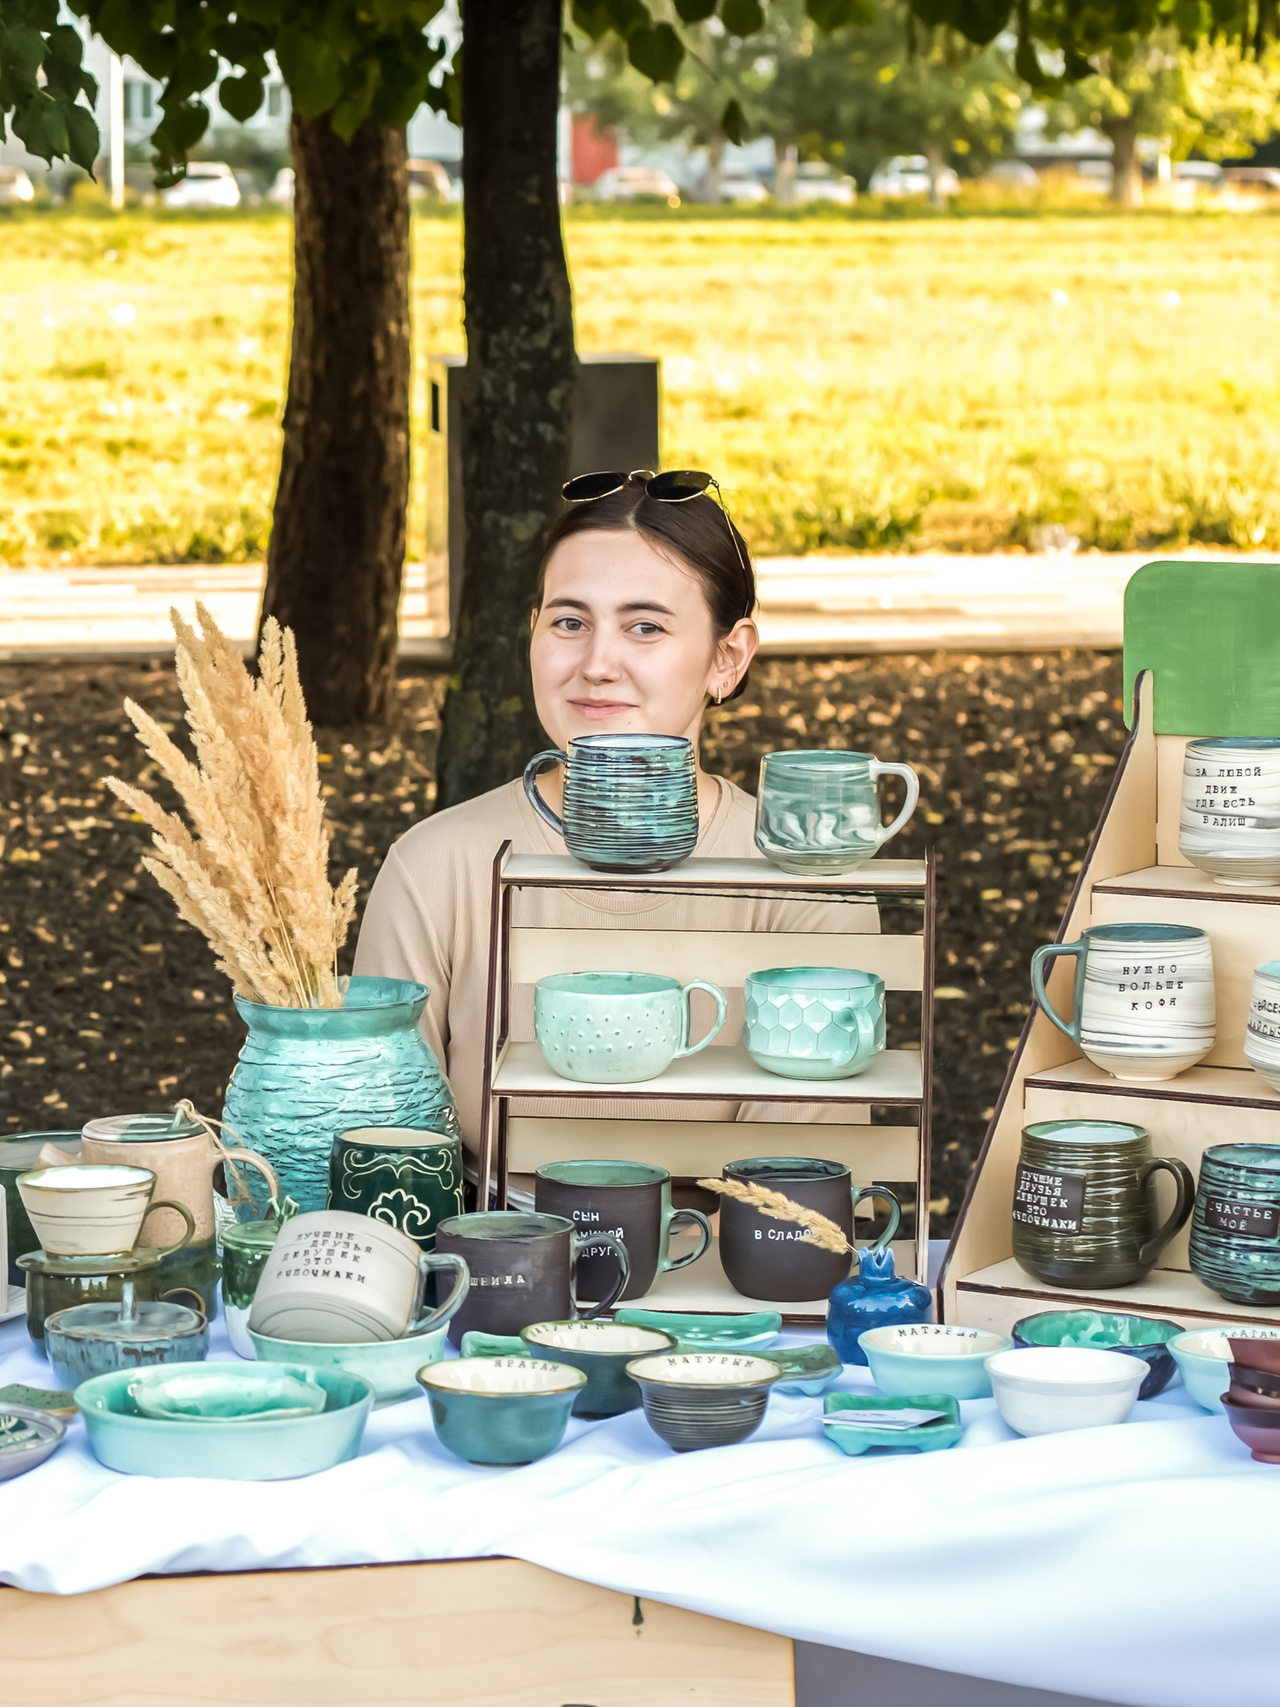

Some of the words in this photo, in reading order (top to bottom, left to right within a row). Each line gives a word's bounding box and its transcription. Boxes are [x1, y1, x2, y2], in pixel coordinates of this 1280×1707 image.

[1195, 768, 1207, 777] ЗА
[1217, 766, 1262, 777] ЛЮБОЙ
[1205, 785, 1238, 795] ДВИЖ
[1195, 799, 1215, 808] ГДЕ
[1223, 797, 1256, 808] ЕСТЬ
[1122, 964, 1177, 975] НУЖНО
[1118, 980, 1184, 992] БОЛЬШЕ
[1021, 1170, 1063, 1186] ЛУЧШИЕ
[1019, 1180, 1062, 1197] ДРУЗЬЯ
[572, 1210, 600, 1222] СЫН
[1026, 1204, 1048, 1216] ЭТО
[295, 1230, 355, 1241] ЛУЧШИЕ
[754, 1229, 763, 1240] В
[309, 1239, 373, 1254] ДРУЗЬЯ
[281, 1248, 361, 1263] ДЕВУШЕК
[303, 1257, 333, 1266] ЭТО
[455, 1274, 526, 1287] ШНИЛА
